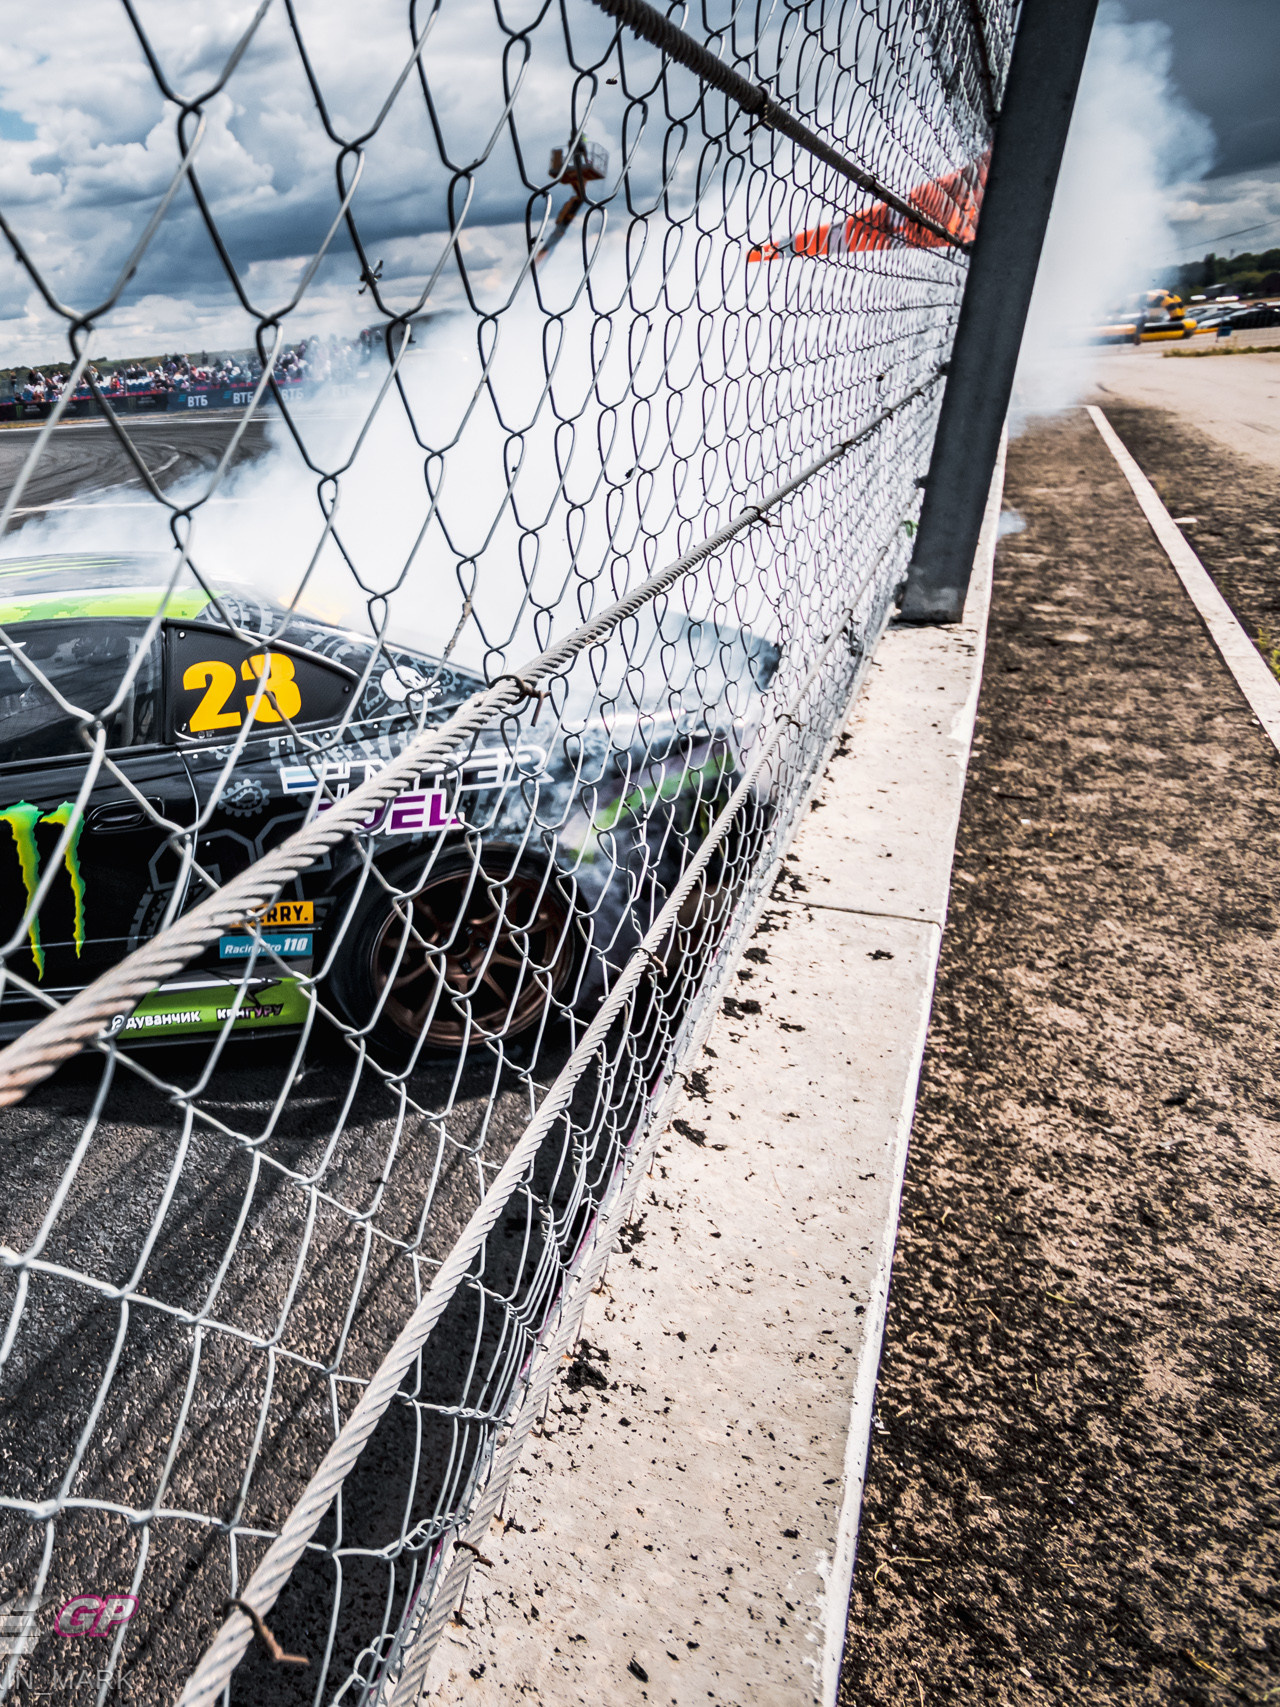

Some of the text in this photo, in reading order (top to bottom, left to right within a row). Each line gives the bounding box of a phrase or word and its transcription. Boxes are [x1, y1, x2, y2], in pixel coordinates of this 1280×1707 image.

[187, 395, 209, 407] ВТБ
[233, 391, 255, 404] ВТБ
[182, 652, 302, 733] 23
[283, 937, 308, 952] 110
